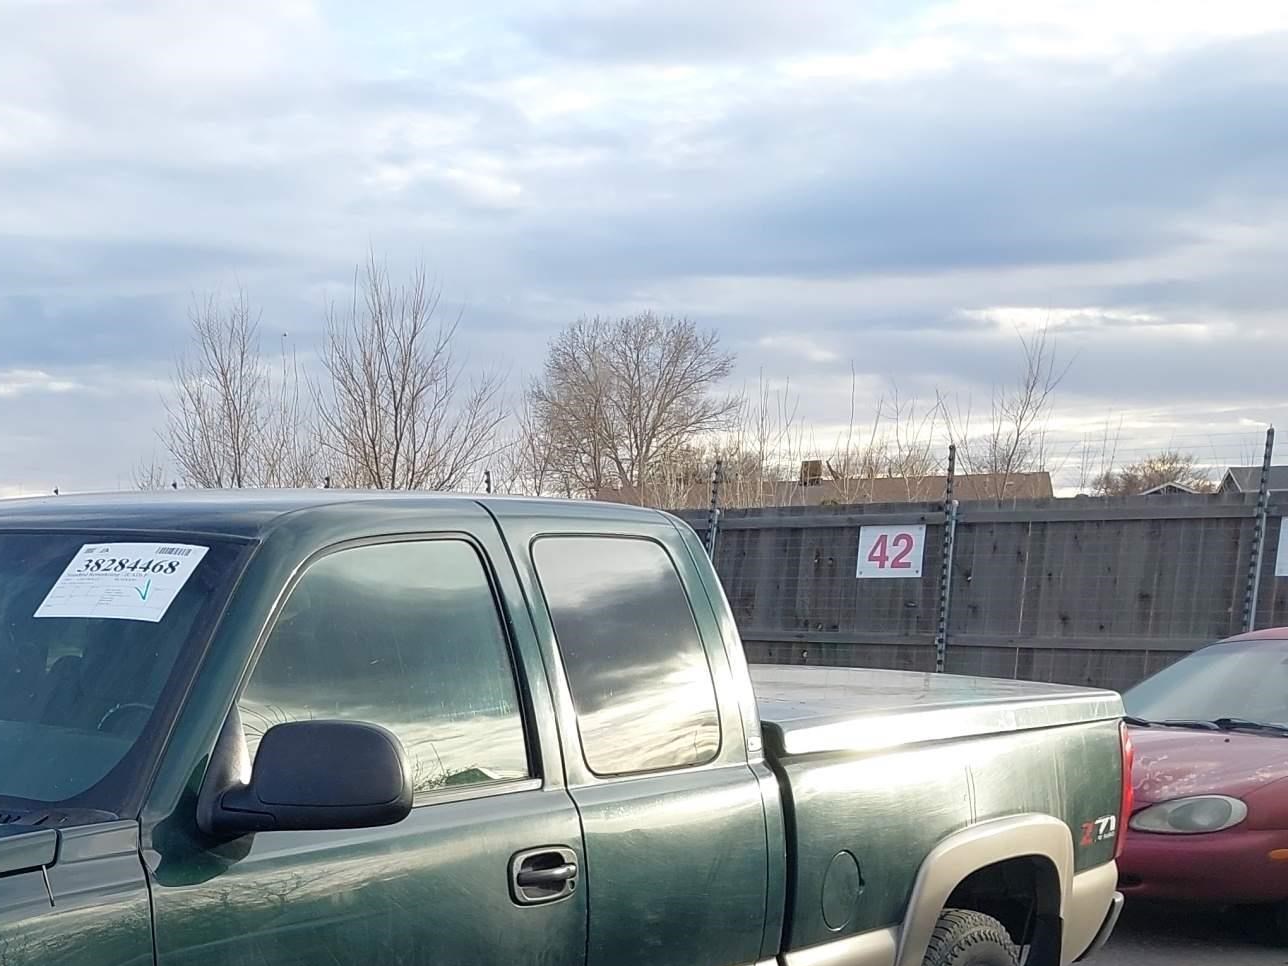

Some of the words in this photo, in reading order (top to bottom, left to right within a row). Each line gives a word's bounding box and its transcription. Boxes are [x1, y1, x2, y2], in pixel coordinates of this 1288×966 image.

[76, 558, 181, 575] 38284468
[868, 533, 914, 569] 42
[1079, 814, 1117, 847] Z71
